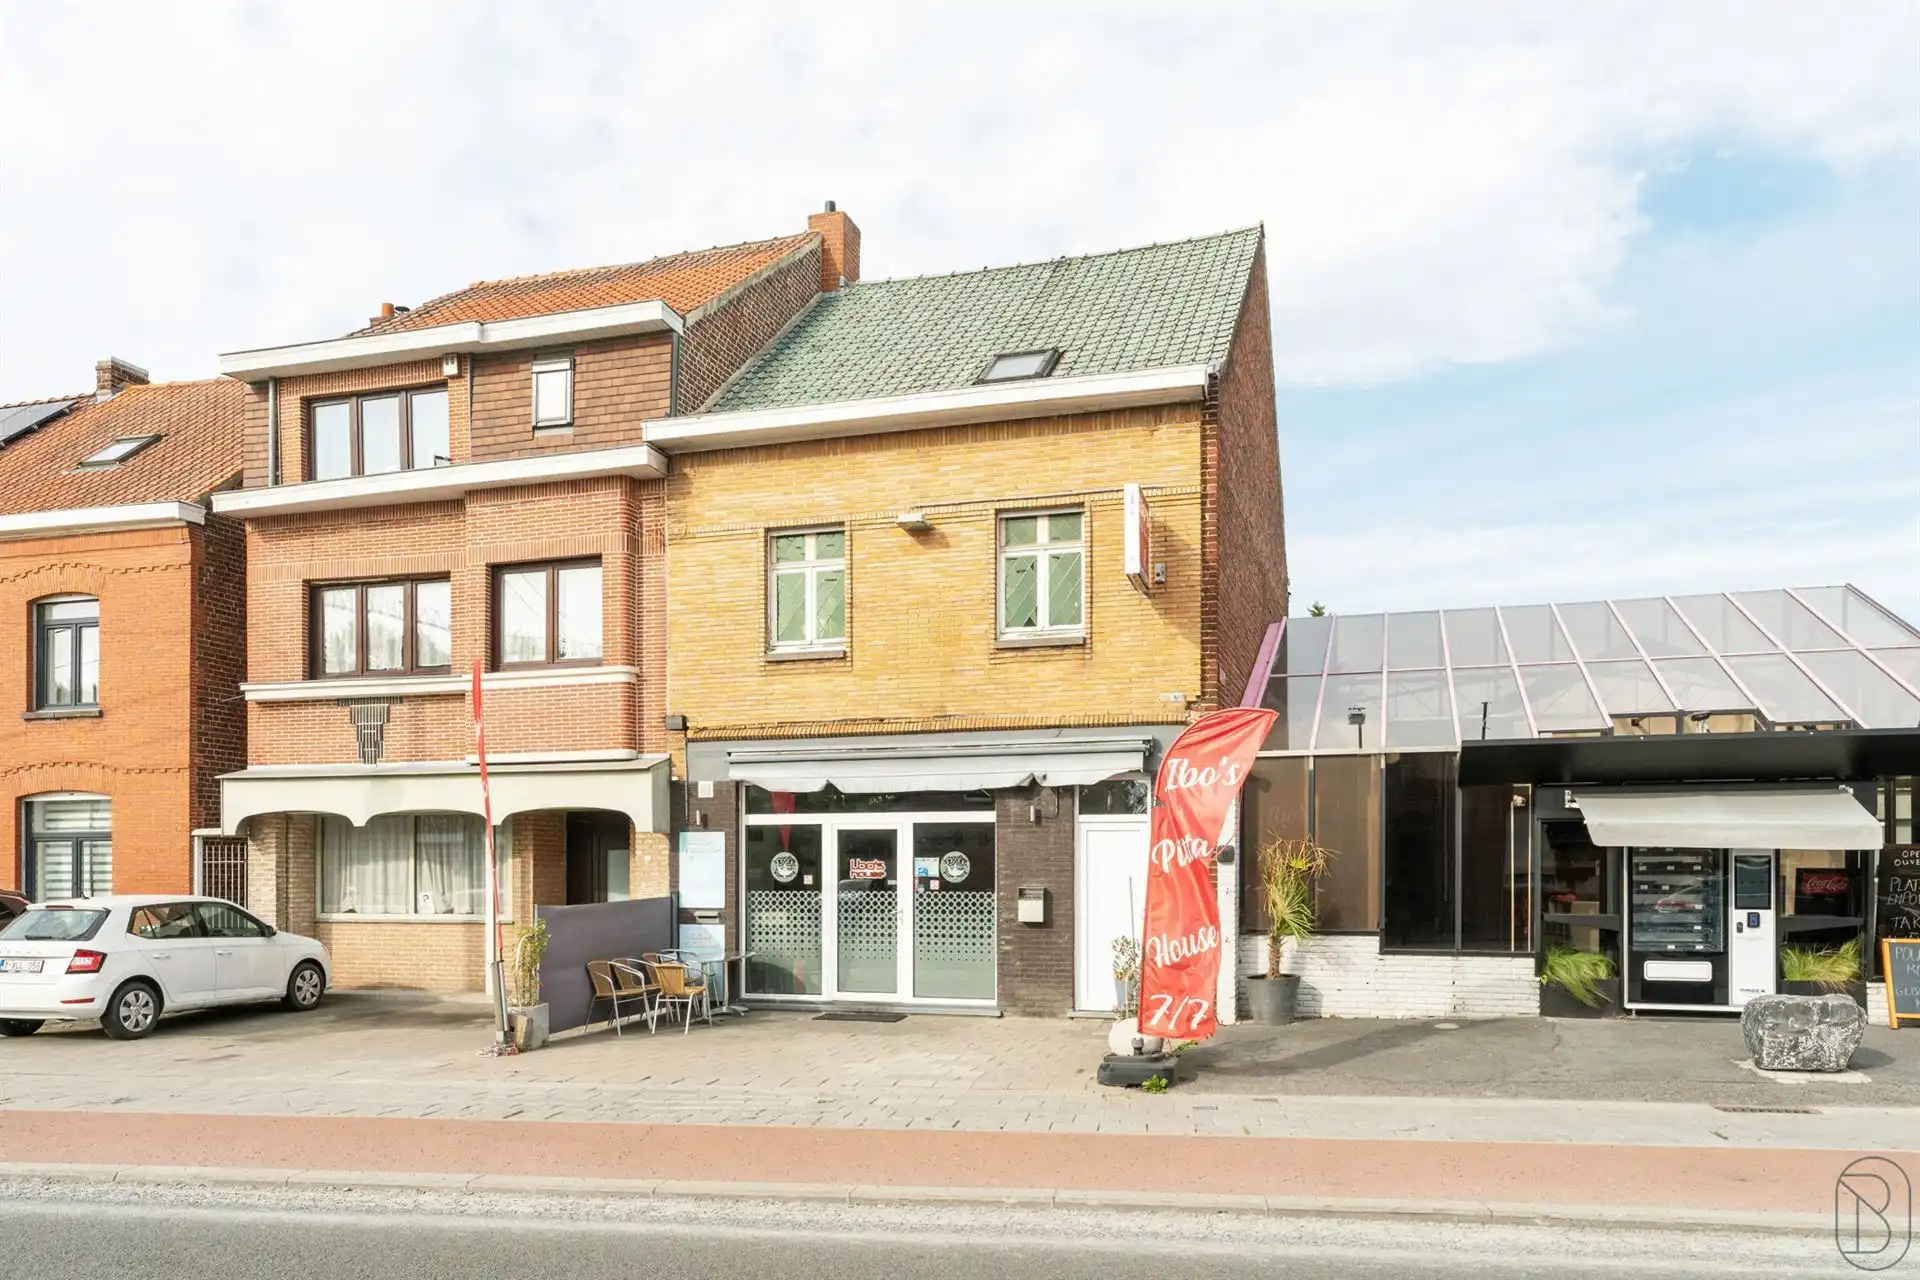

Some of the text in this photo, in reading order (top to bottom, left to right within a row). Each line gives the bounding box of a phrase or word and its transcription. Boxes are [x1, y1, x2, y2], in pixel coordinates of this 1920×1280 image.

[1165, 756, 1243, 792] Ibo's
[1152, 833, 1214, 874] Pitta
[1886, 891, 1920, 905] EMPO
[1890, 876, 1920, 893] PLAT
[1146, 925, 1219, 968] House
[1150, 994, 1209, 1031] 7/7
